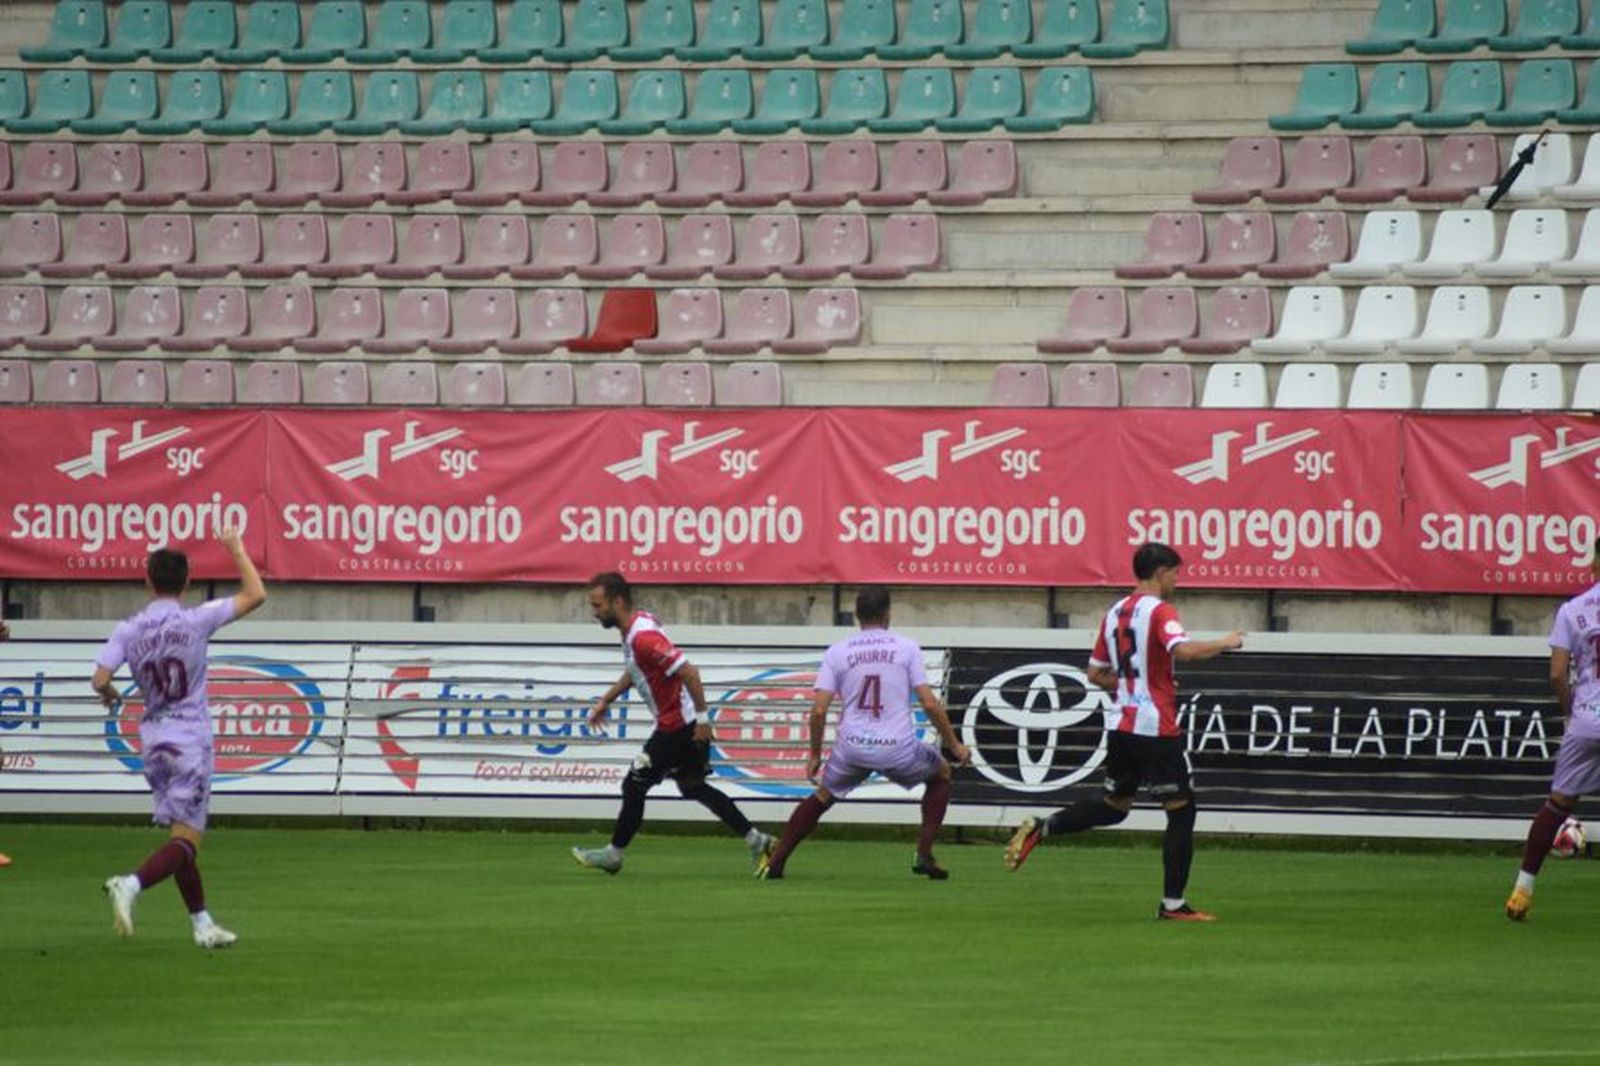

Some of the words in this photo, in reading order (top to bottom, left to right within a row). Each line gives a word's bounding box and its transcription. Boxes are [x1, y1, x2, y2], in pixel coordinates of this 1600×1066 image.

[166, 446, 205, 476] sgc
[439, 448, 479, 479] sgc
[719, 448, 760, 480] sgc
[1001, 448, 1041, 480] sgc
[1294, 450, 1336, 482] sgc
[11, 492, 248, 552] sangregorio
[283, 495, 522, 556] sangregorio
[560, 495, 804, 557] sangregorio
[838, 496, 1086, 558] sangregorio
[1127, 499, 1382, 560] sangregorio
[1420, 513, 1600, 567] sangreg
[847, 649, 897, 669] CHURRE
[857, 674, 884, 719] 4
[1248, 704, 1314, 756] DE
[1330, 706, 1388, 758] LA
[1404, 707, 1550, 760] PLATA
